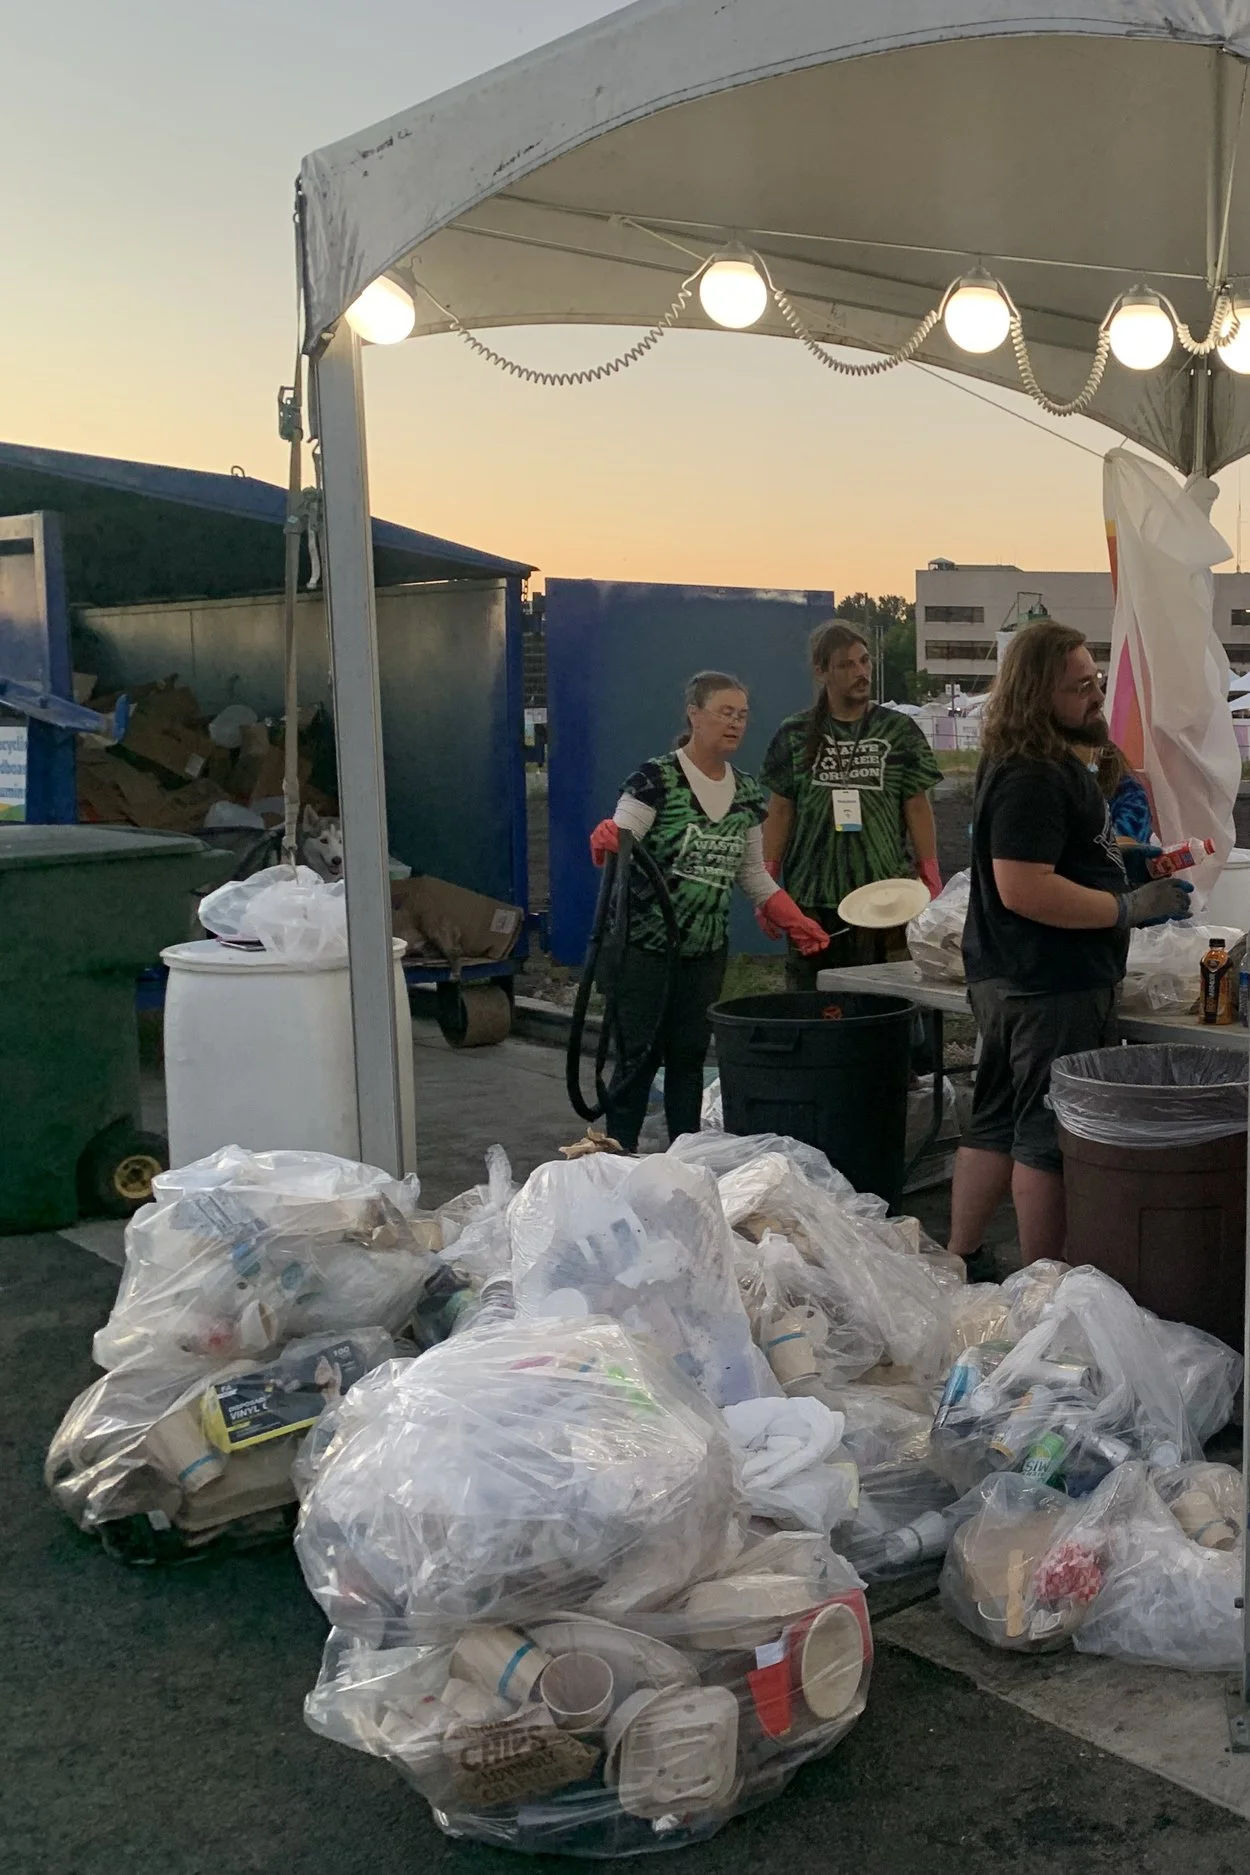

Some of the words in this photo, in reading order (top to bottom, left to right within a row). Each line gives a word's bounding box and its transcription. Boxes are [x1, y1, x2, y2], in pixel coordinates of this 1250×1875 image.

[826, 744, 880, 756] WASTE
[841, 756, 880, 768] FREE
[693, 840, 745, 854] WASTE
[229, 1407, 260, 1421] VINYL
[460, 1726, 548, 1772] CHIPS
